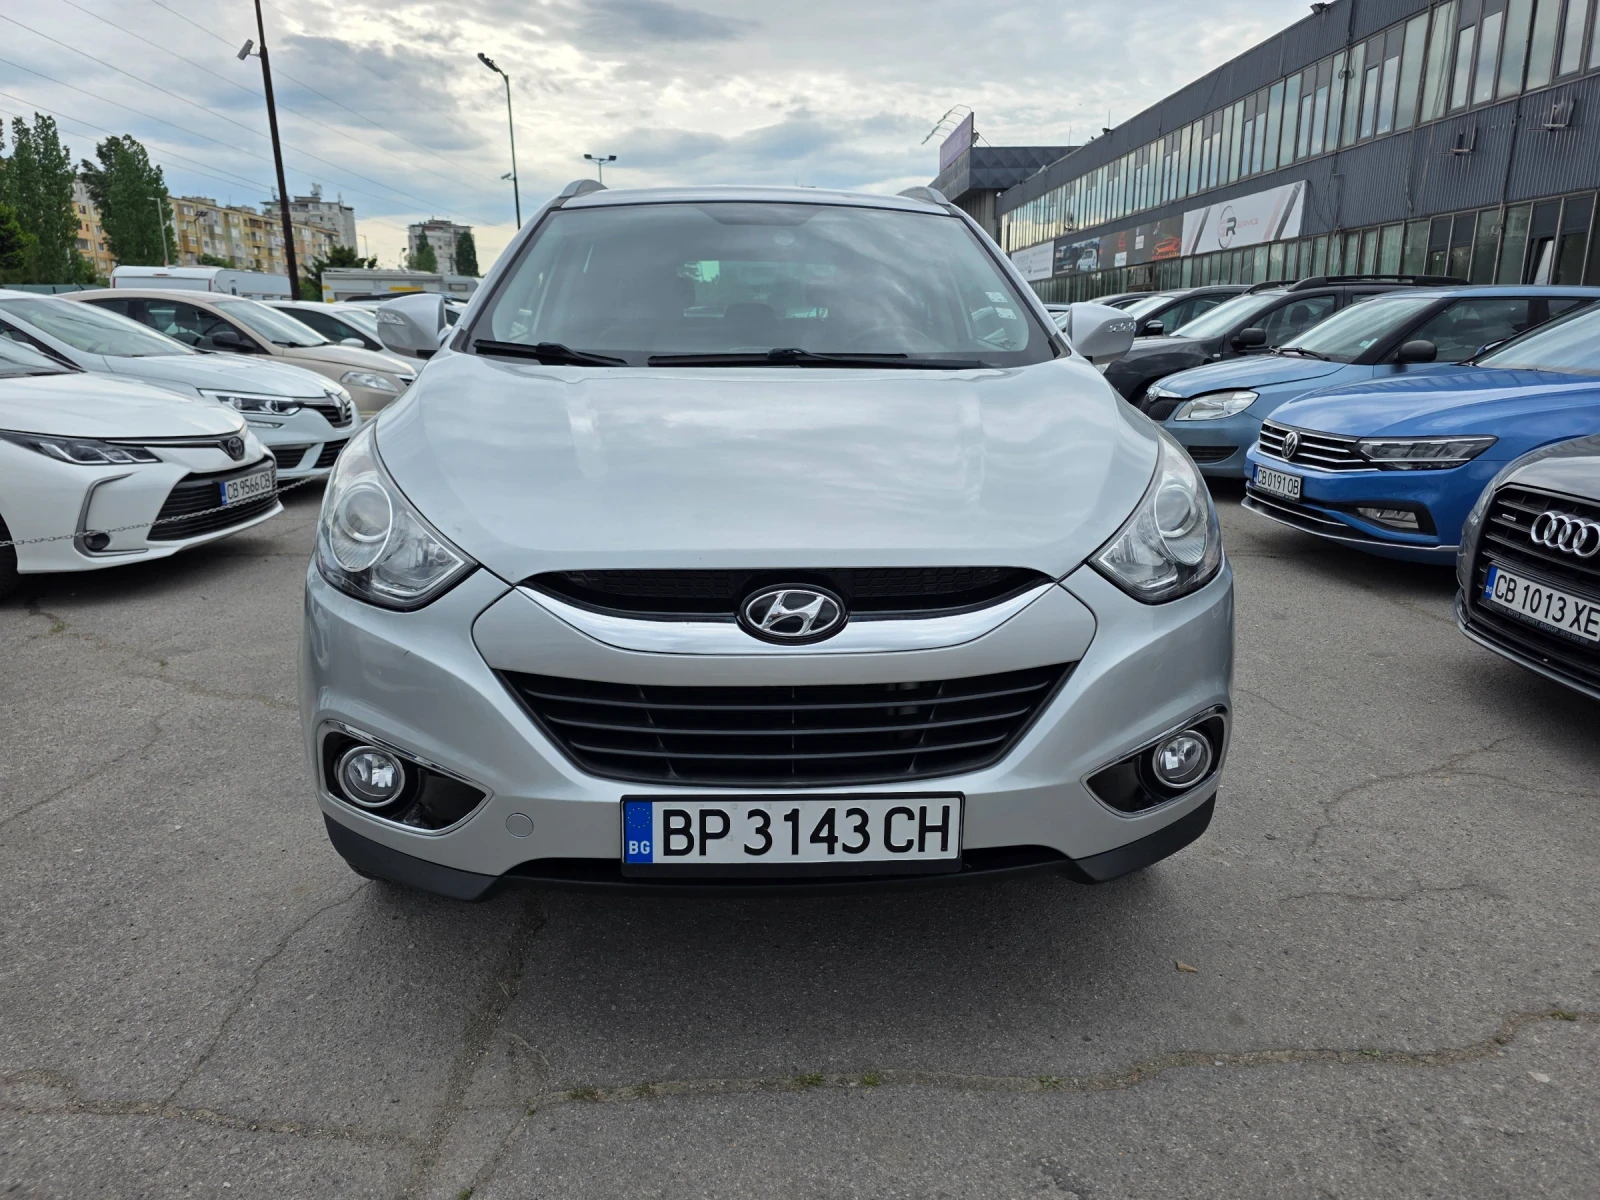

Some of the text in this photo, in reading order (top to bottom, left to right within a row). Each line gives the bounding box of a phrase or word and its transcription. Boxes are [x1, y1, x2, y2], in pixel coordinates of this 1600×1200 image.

[1237, 218, 1259, 228] SERVICE
[227, 473, 270, 499] CB 9566 CB
[1258, 469, 1266, 485] CB
[1268, 472, 1286, 491] 0191
[1288, 478, 1299, 495] OB
[1485, 586, 1493, 594] BG
[1495, 574, 1600, 637] CB 1013 XE
[1540, 622, 1558, 632] GROUP
[662, 805, 951, 857] BP 3143 CH
[628, 840, 650, 855] BG
